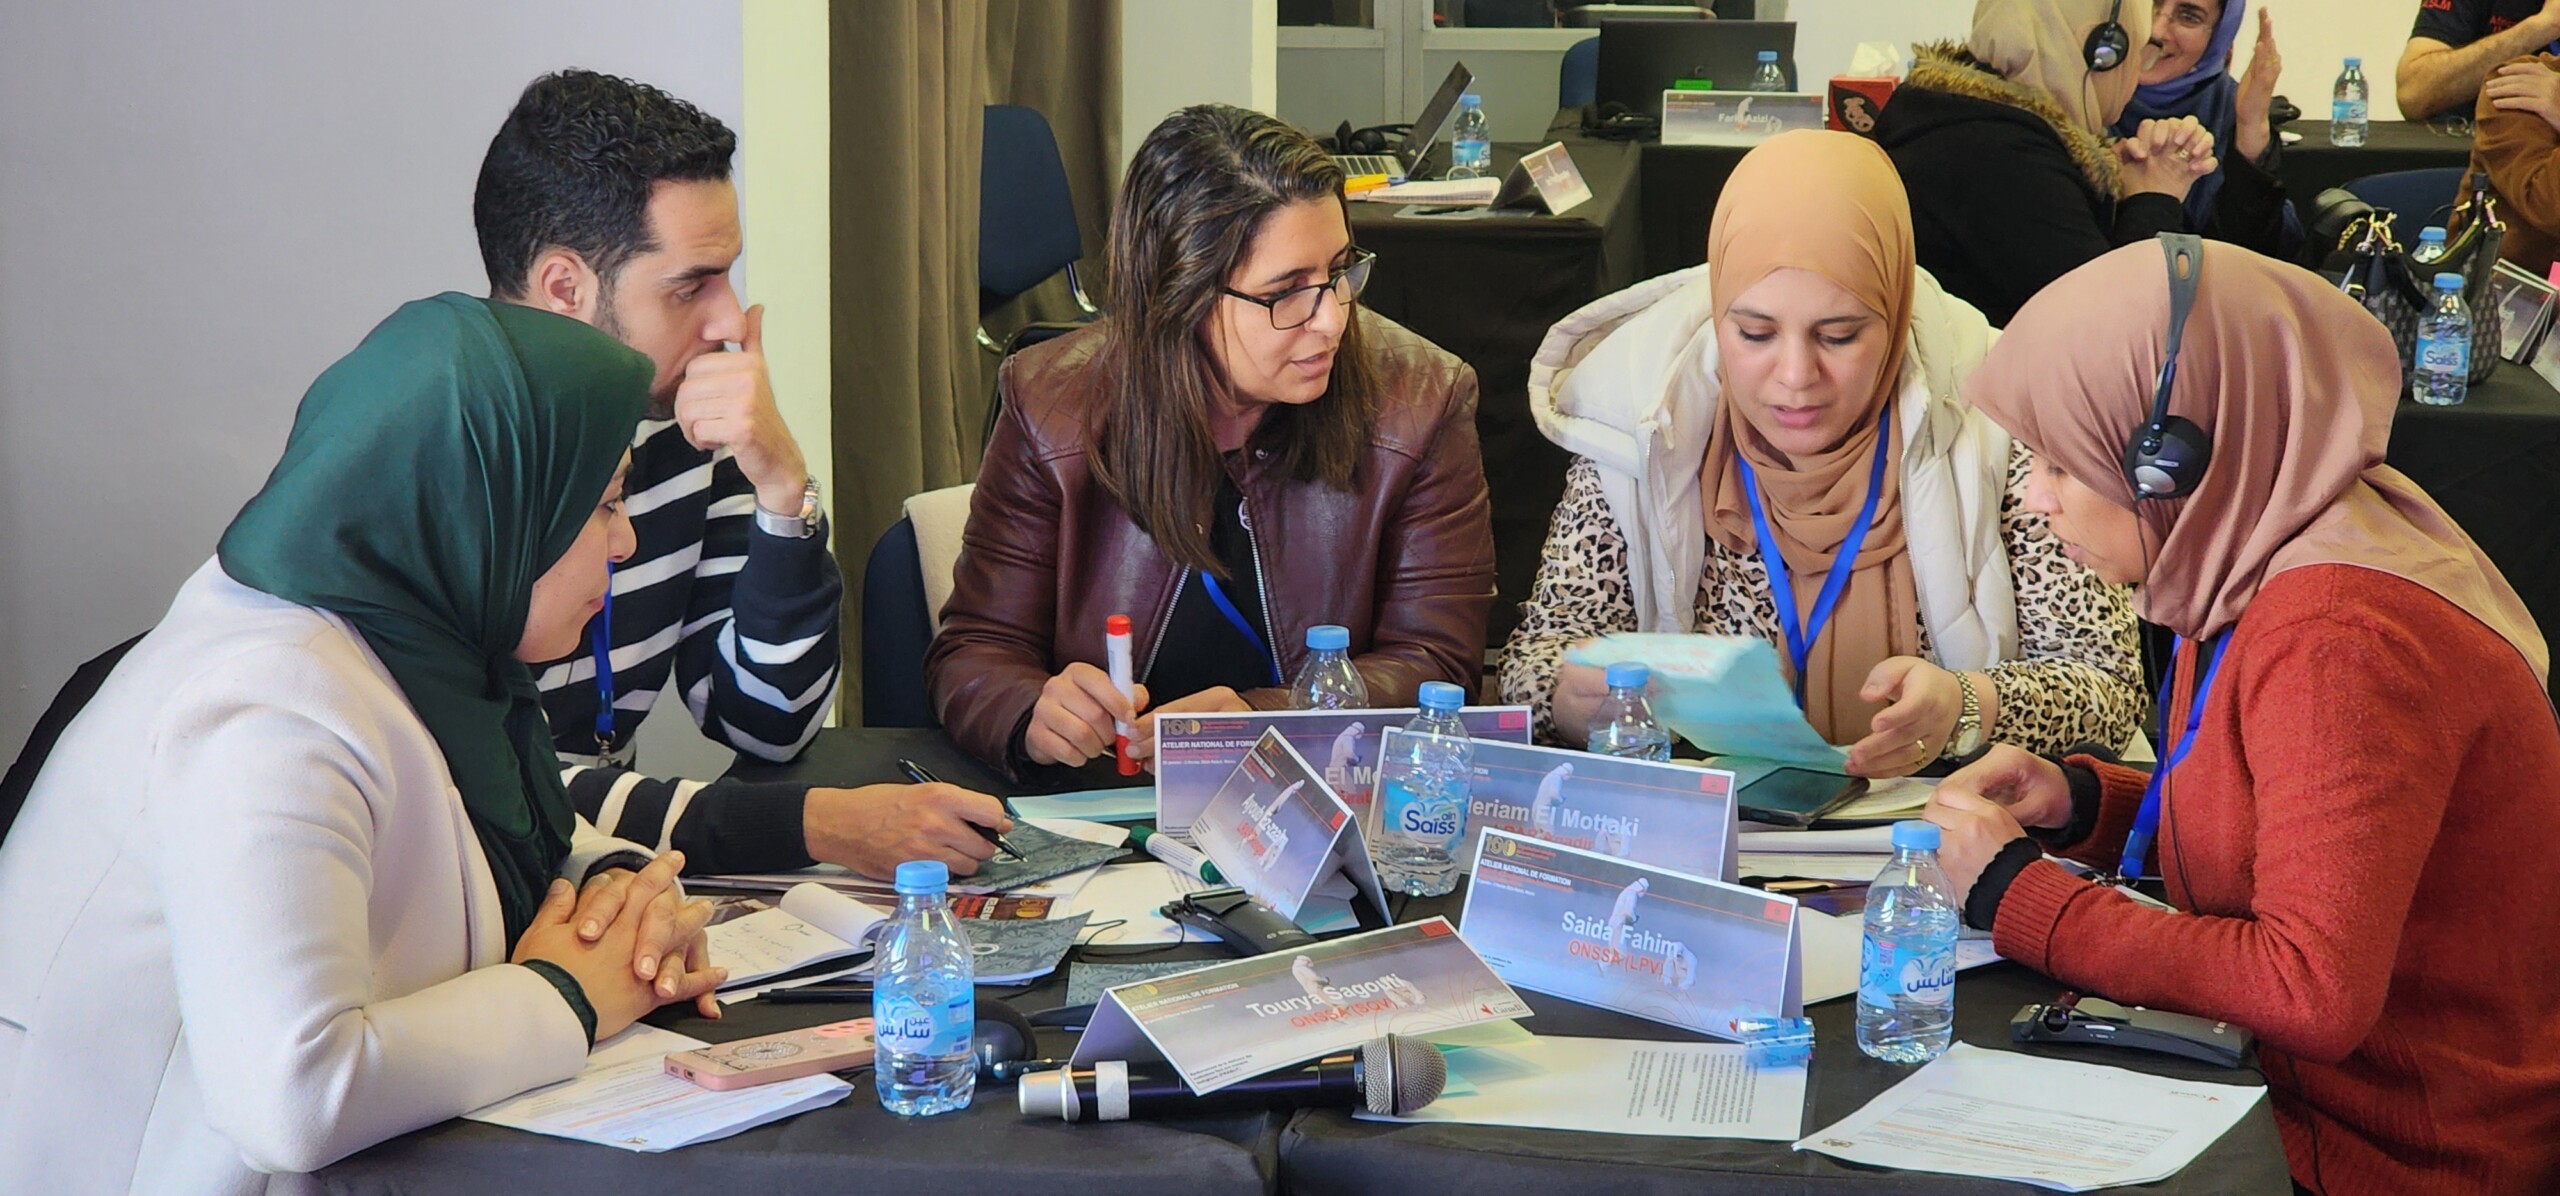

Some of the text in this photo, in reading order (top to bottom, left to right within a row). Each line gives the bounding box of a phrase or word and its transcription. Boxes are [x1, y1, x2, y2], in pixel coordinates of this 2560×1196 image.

[1162, 741, 1190, 749] ATELIER
[1325, 767, 1346, 785] El
[1442, 811, 1456, 821] ain
[1468, 796, 1640, 837] eriam El Mottaki
[1561, 910, 1679, 957] Saida Fahim
[1569, 940, 1665, 977] ONSSA (LPV)
[1245, 992, 1322, 1018] Tourya
[1290, 1007, 1349, 1028] ONSSA
